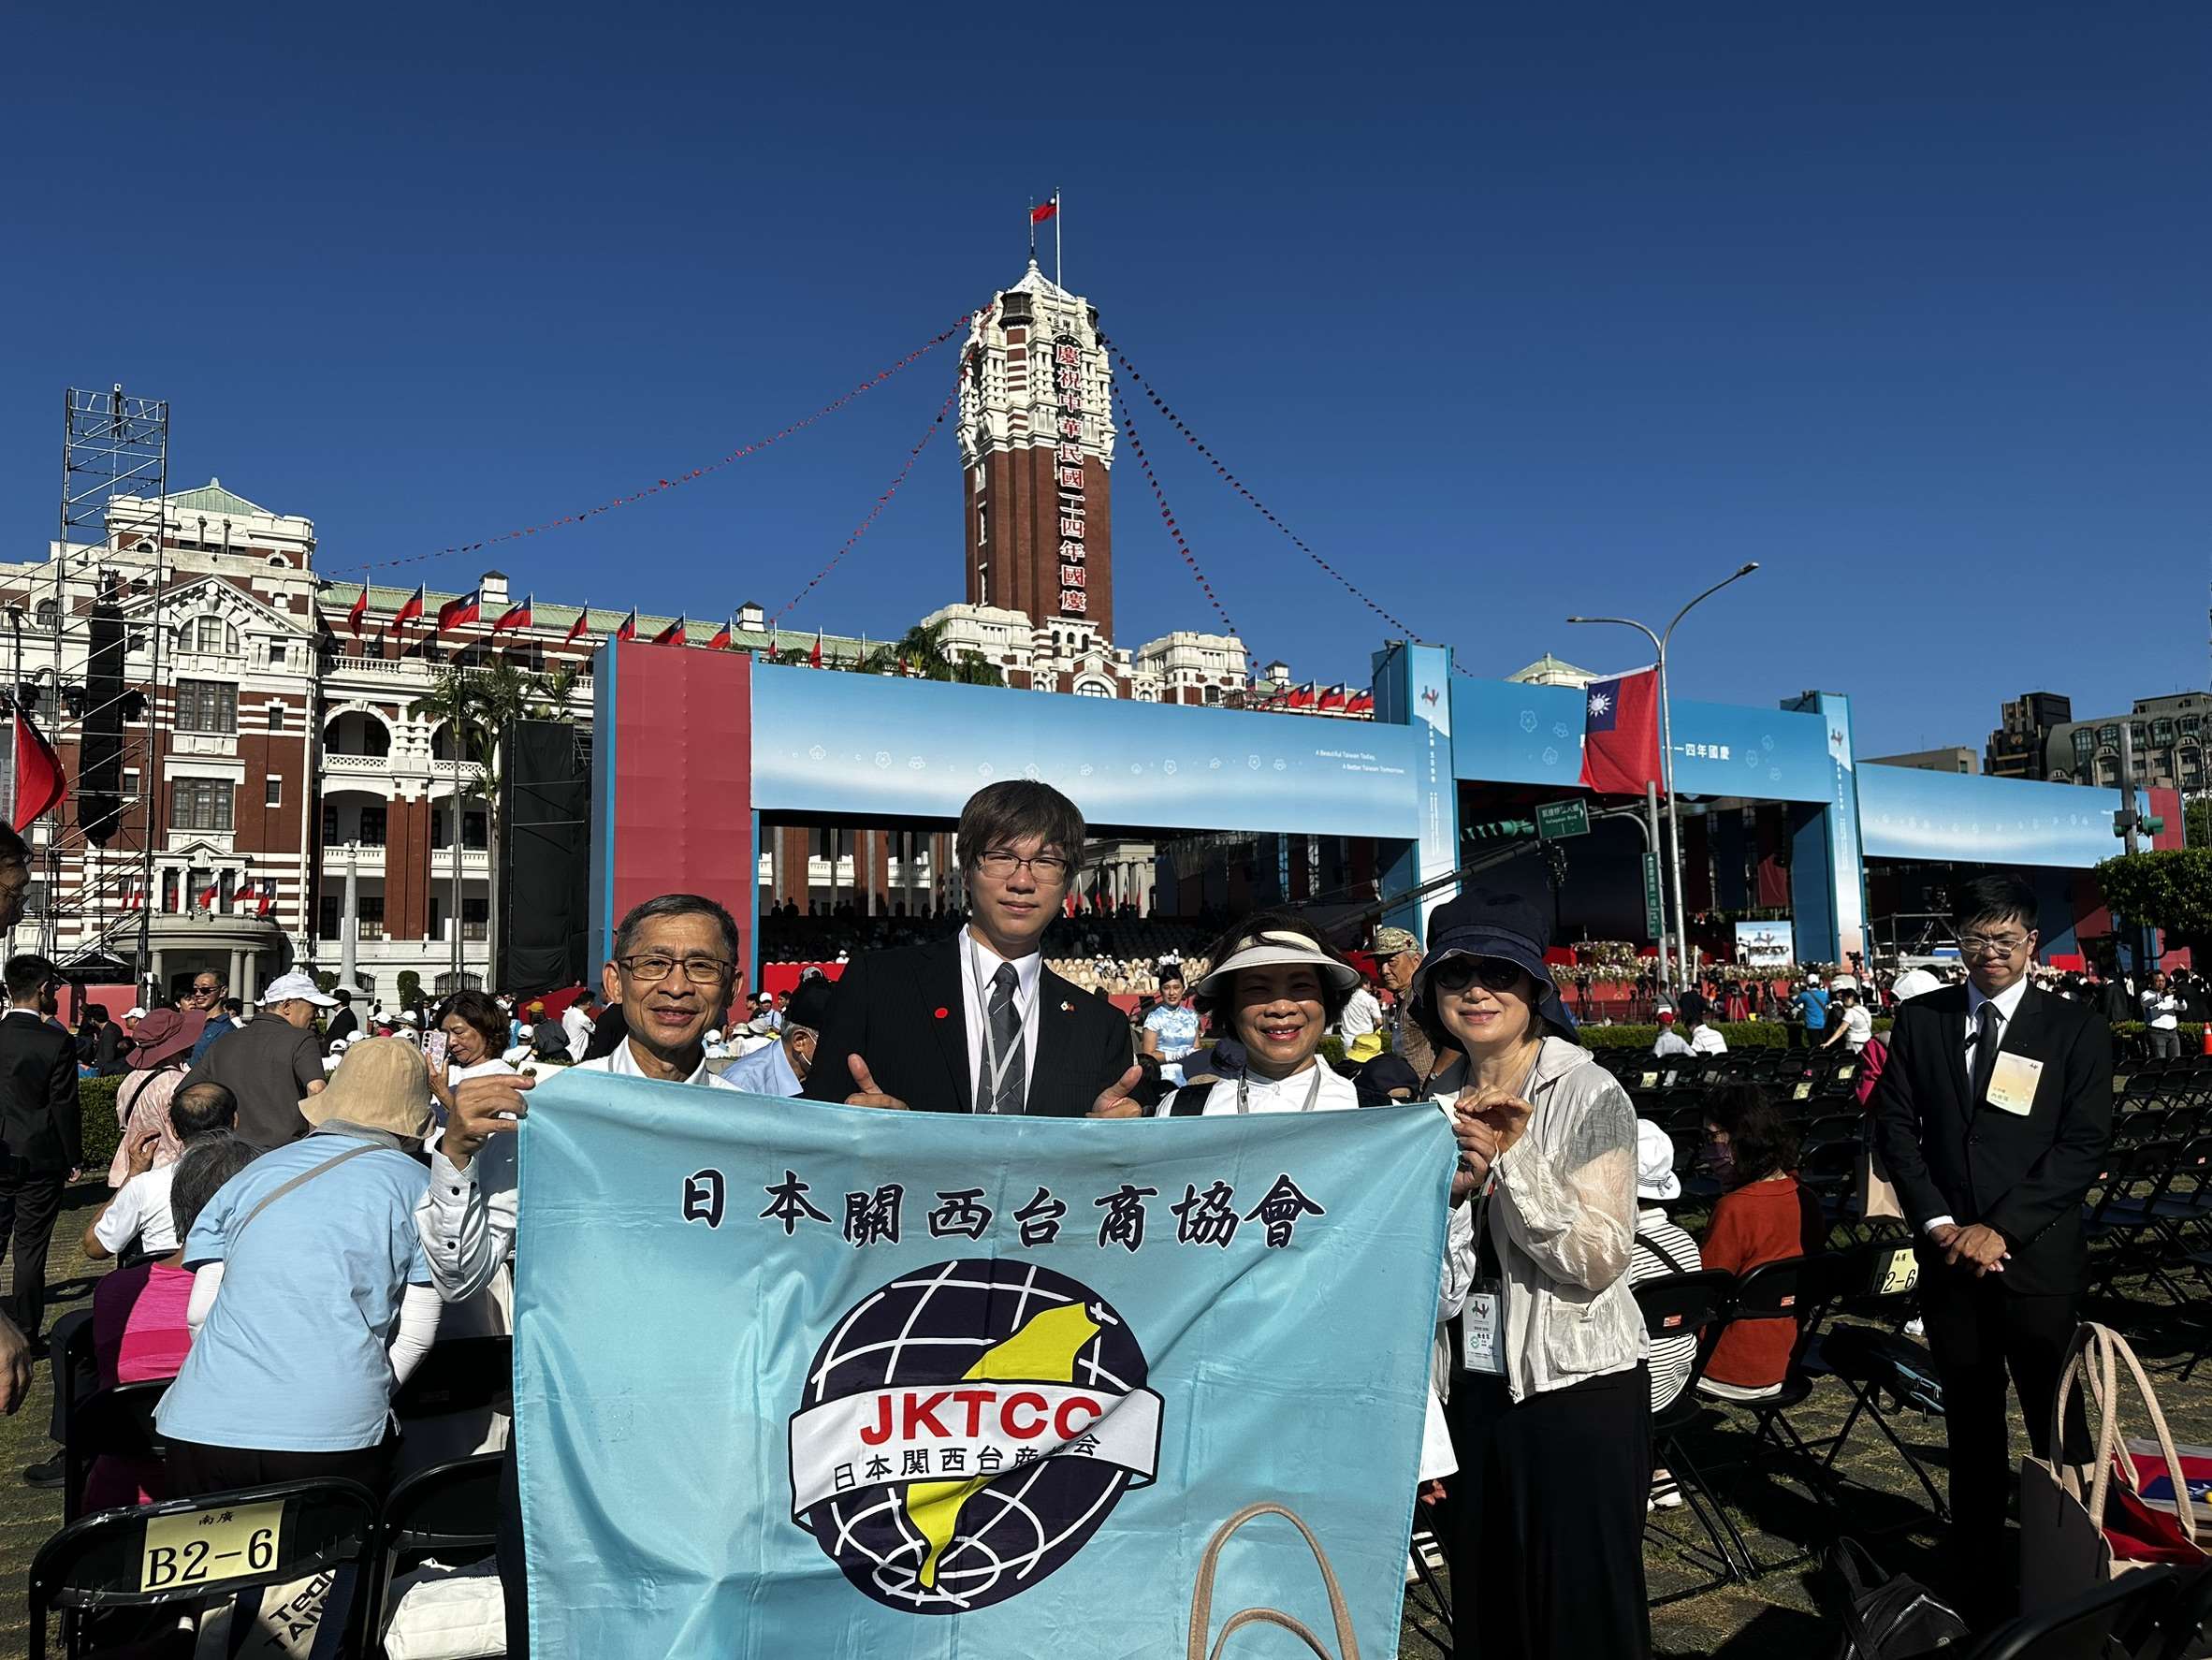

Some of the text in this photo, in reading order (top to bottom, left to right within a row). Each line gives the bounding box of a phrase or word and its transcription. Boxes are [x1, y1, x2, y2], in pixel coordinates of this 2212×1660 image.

[1056, 344, 1086, 612] 慶祝中華民國一一四年國慶
[682, 1169, 1324, 1252] 日本關西台商協會
[860, 1391, 1102, 1446] JKTCC
[834, 1434, 1101, 1492] 日本関西台商会
[145, 1528, 272, 1588] B2-6
